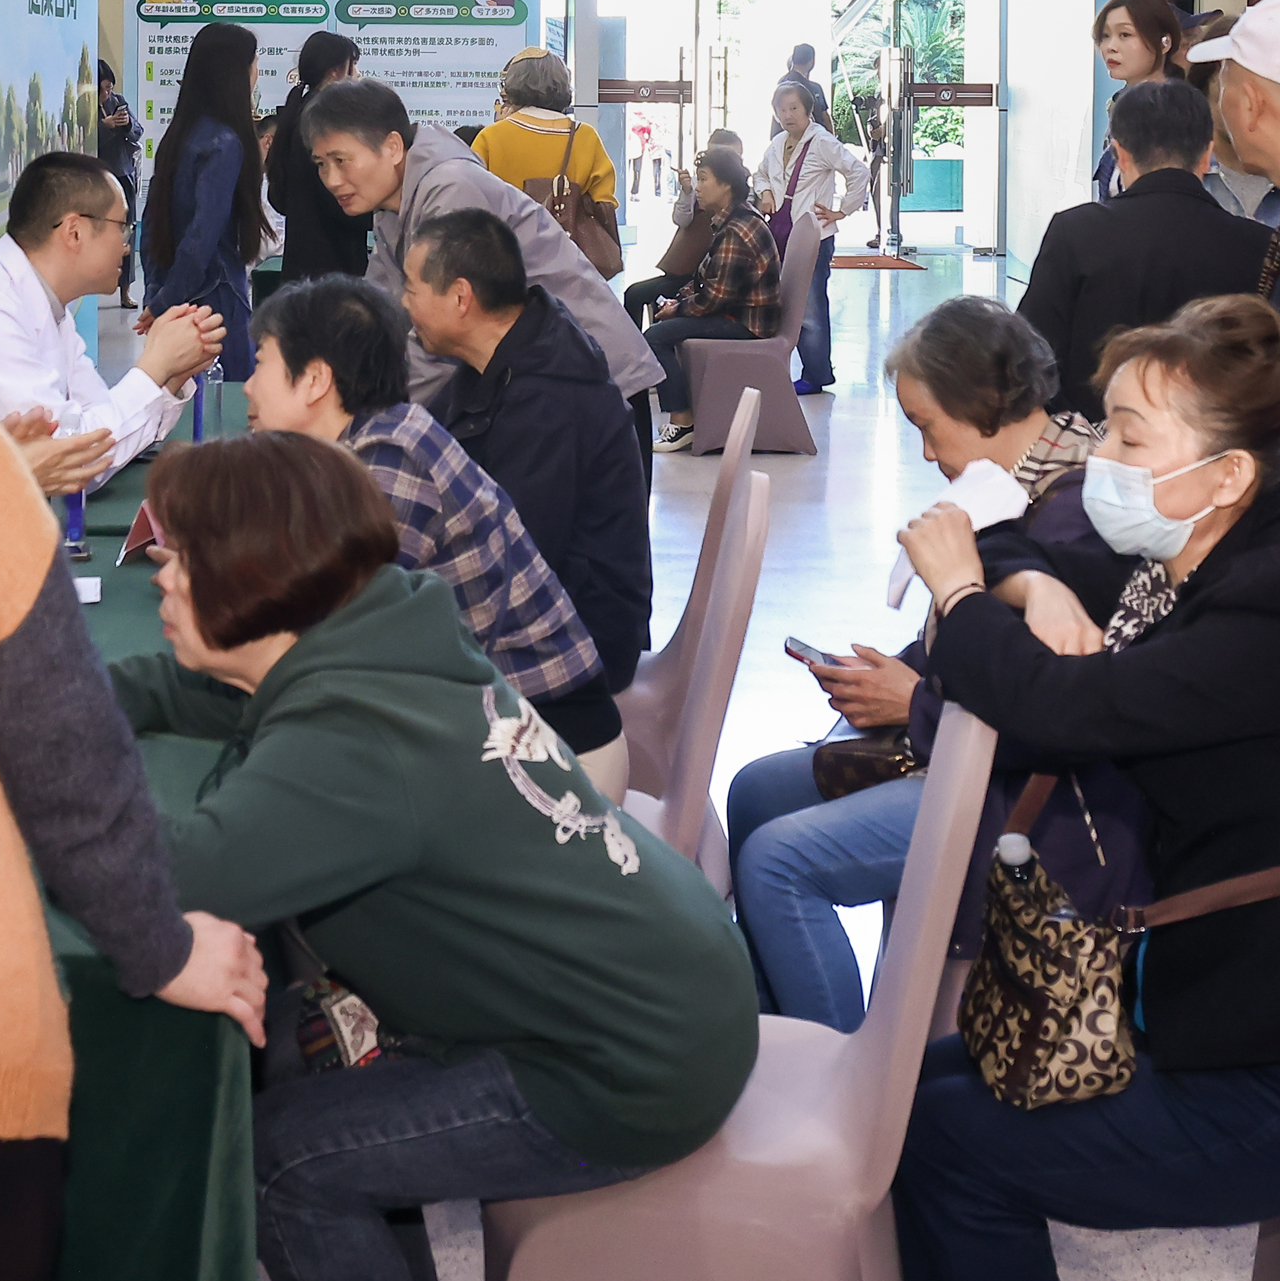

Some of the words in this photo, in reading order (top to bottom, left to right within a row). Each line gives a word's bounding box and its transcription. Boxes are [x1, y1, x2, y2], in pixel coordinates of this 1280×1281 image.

[155, 5, 197, 14] 年龄&慢性病
[227, 6, 263, 14] 感染性疾病
[362, 7, 393, 15] 一次感染
[424, 7, 455, 15] 多方负担
[148, 47, 189, 55] 看看感染性
